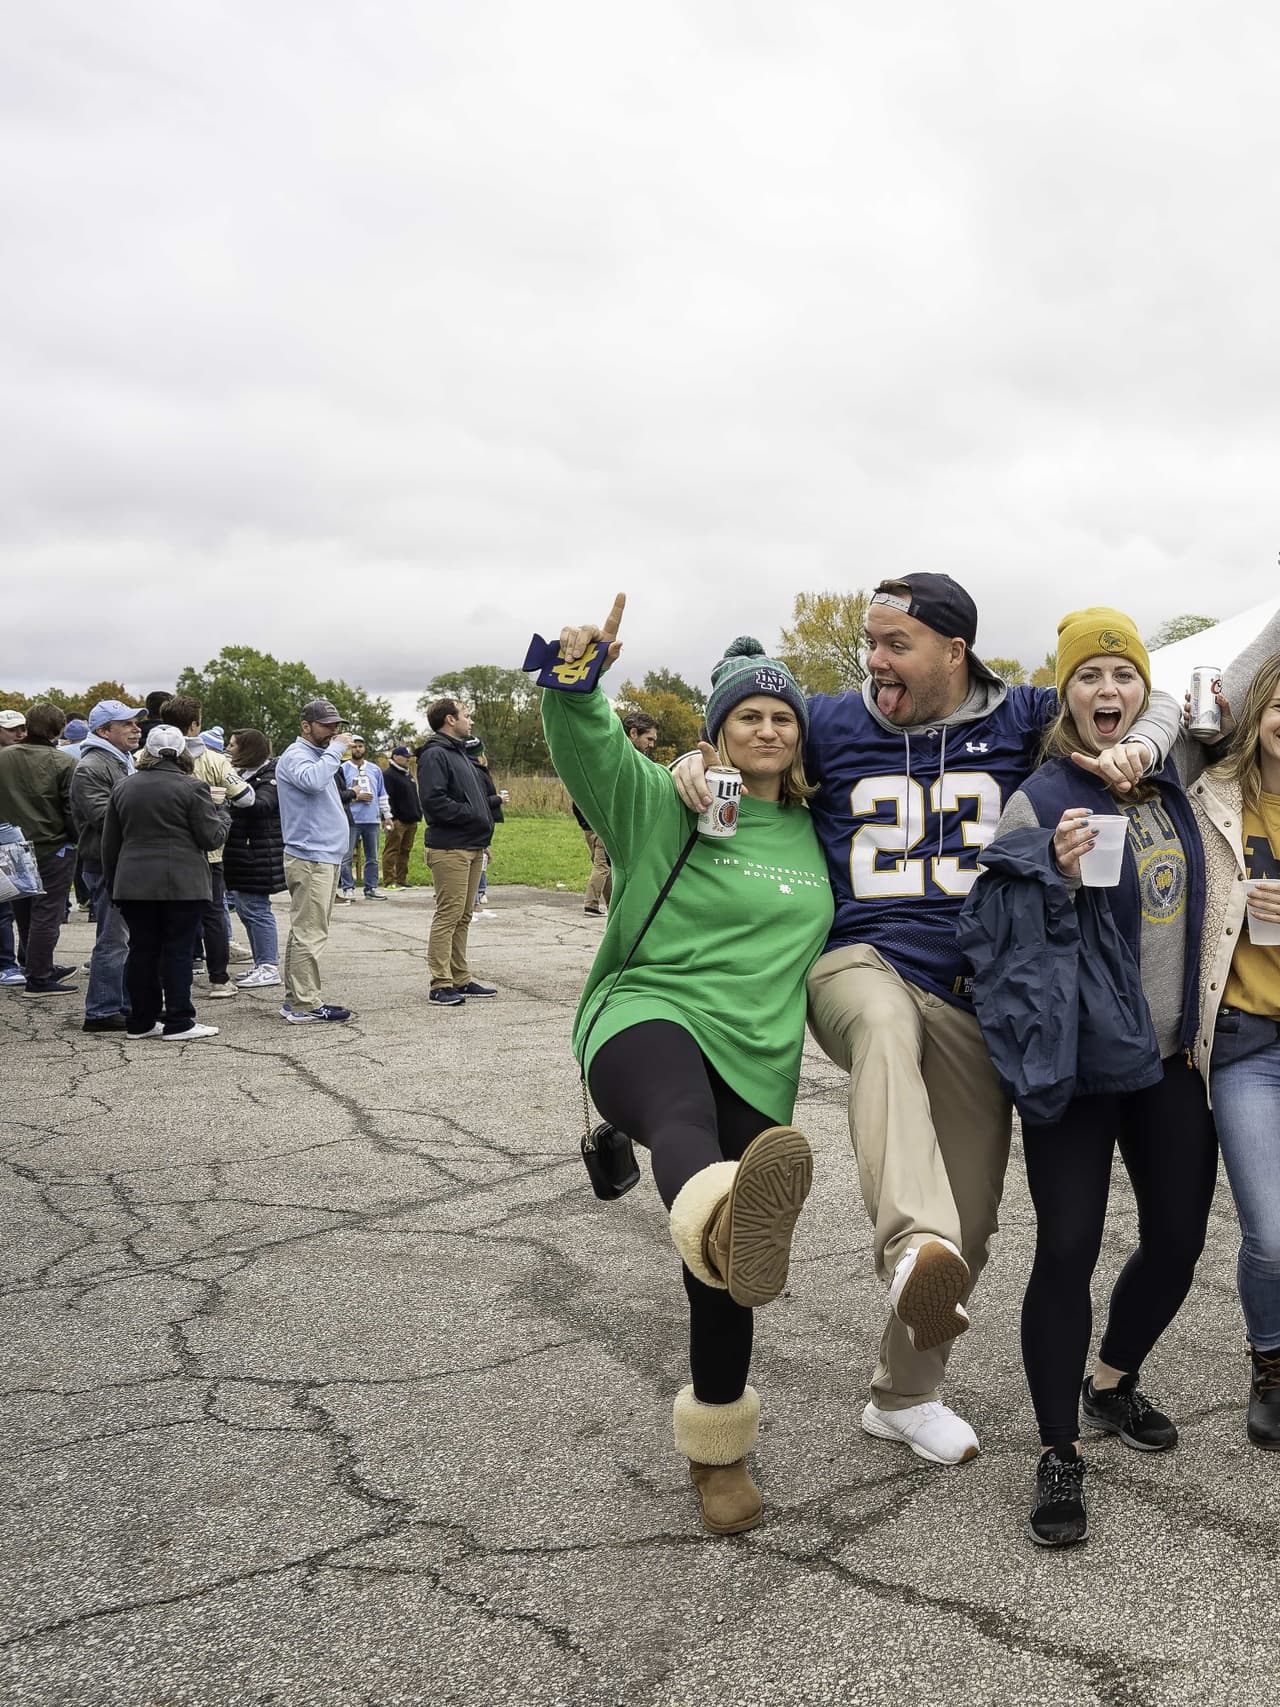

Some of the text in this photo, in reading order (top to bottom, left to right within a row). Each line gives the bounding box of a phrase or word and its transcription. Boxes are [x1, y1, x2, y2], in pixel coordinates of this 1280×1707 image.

[850, 773, 1002, 899] 23
[714, 858, 740, 866] THE
[747, 861, 815, 878] UNIVERSITY
[743, 869, 782, 882] NOTRE
